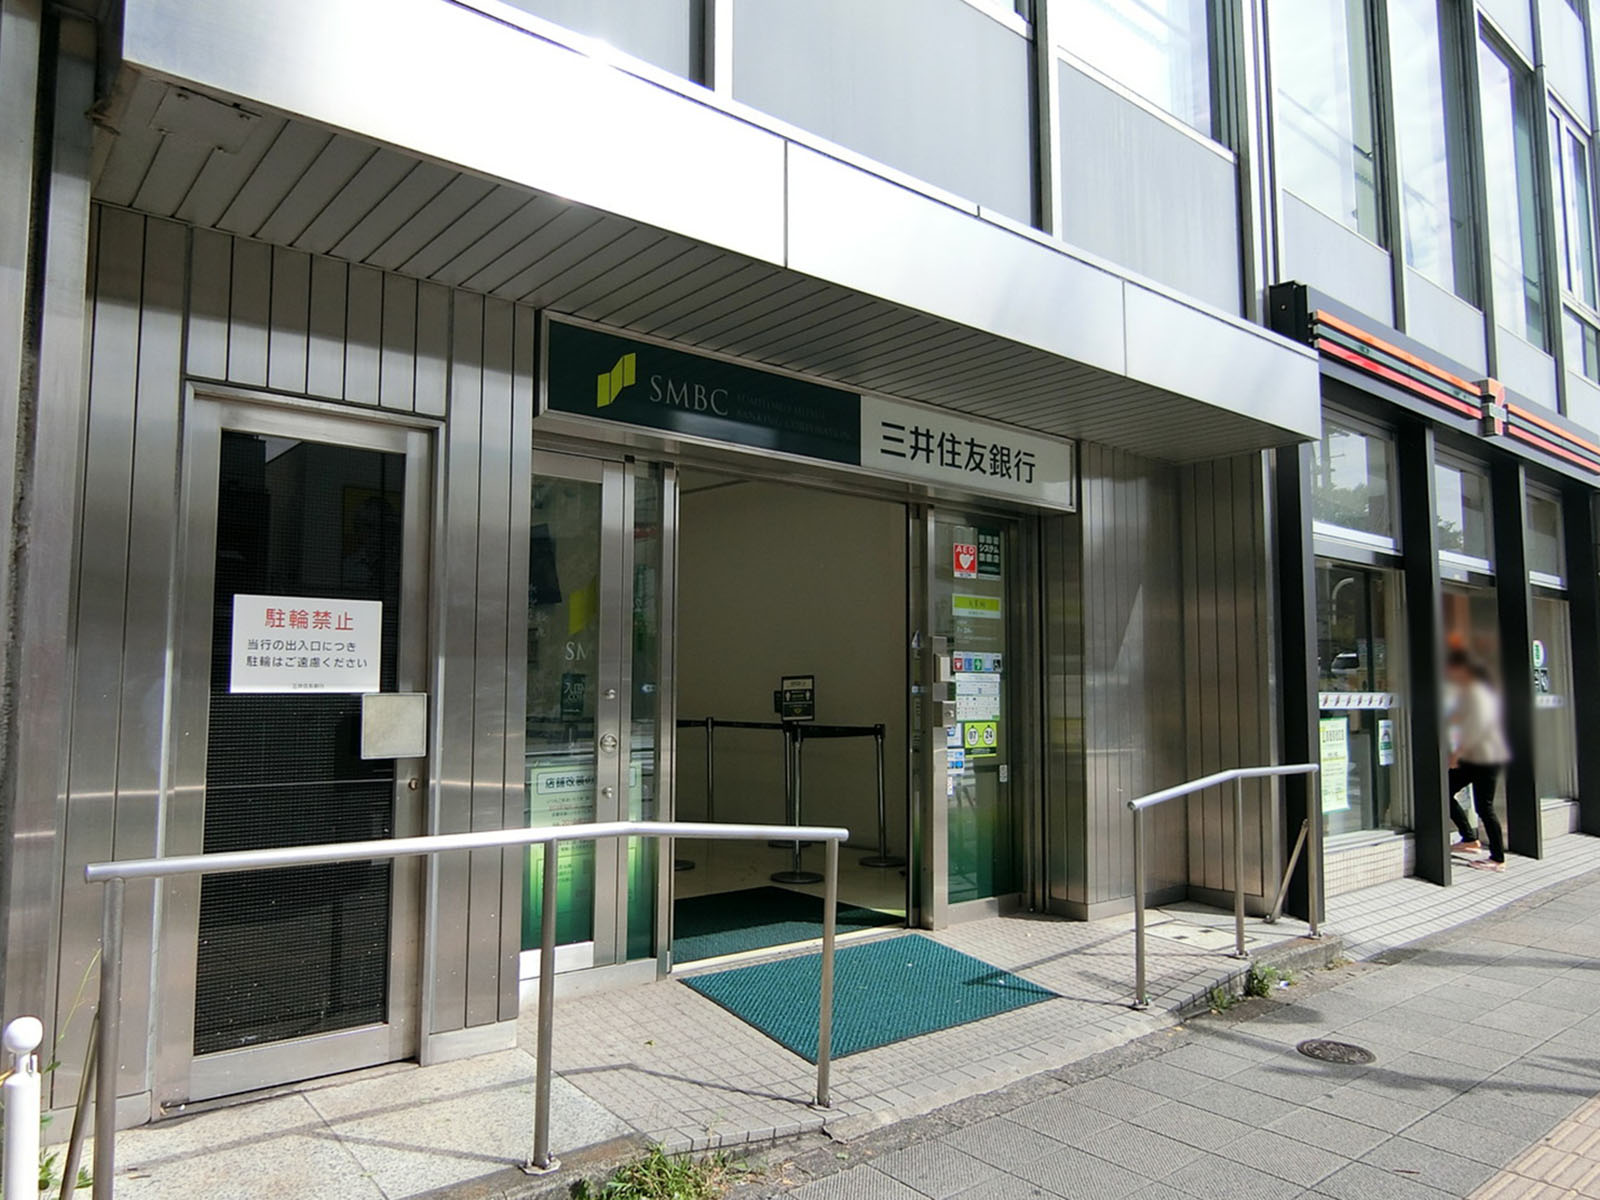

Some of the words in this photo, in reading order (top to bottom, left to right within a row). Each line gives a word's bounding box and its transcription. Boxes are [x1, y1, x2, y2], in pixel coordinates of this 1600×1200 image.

[649, 374, 730, 416] SMBC
[880, 421, 1036, 484] 三井住友銀行
[264, 608, 354, 631] 駐輪禁止
[247, 638, 357, 652] 当行の出入口につき
[246, 655, 368, 669] 駐輪はご遠慮ください
